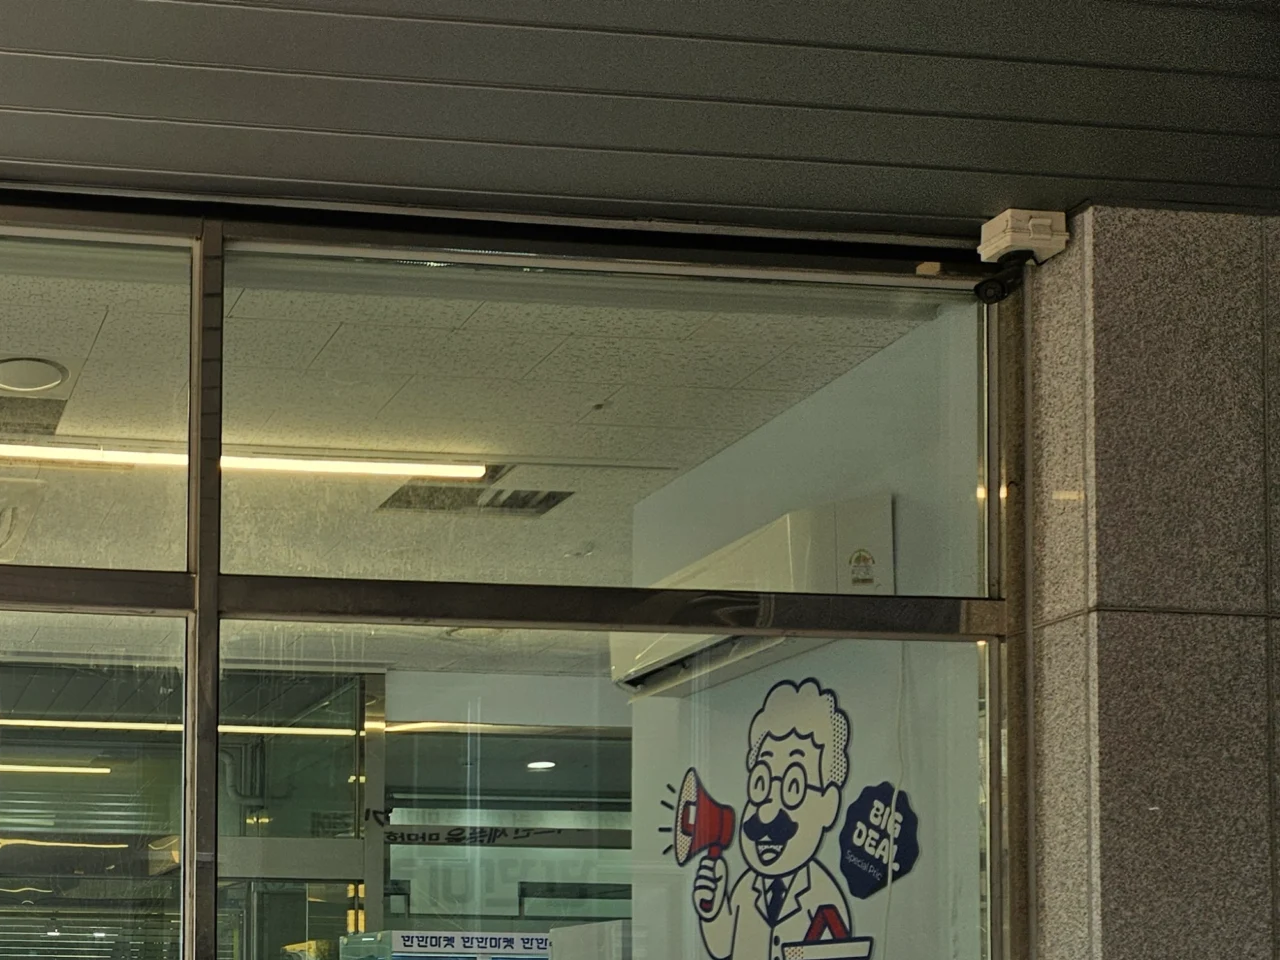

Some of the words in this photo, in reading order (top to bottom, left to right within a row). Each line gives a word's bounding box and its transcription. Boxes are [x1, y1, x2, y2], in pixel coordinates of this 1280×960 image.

[869, 799, 903, 838] BIG
[401, 935, 455, 949] 만만마켓
[461, 936, 515, 950] 만만마켓
[520, 937, 553, 950] 만만
